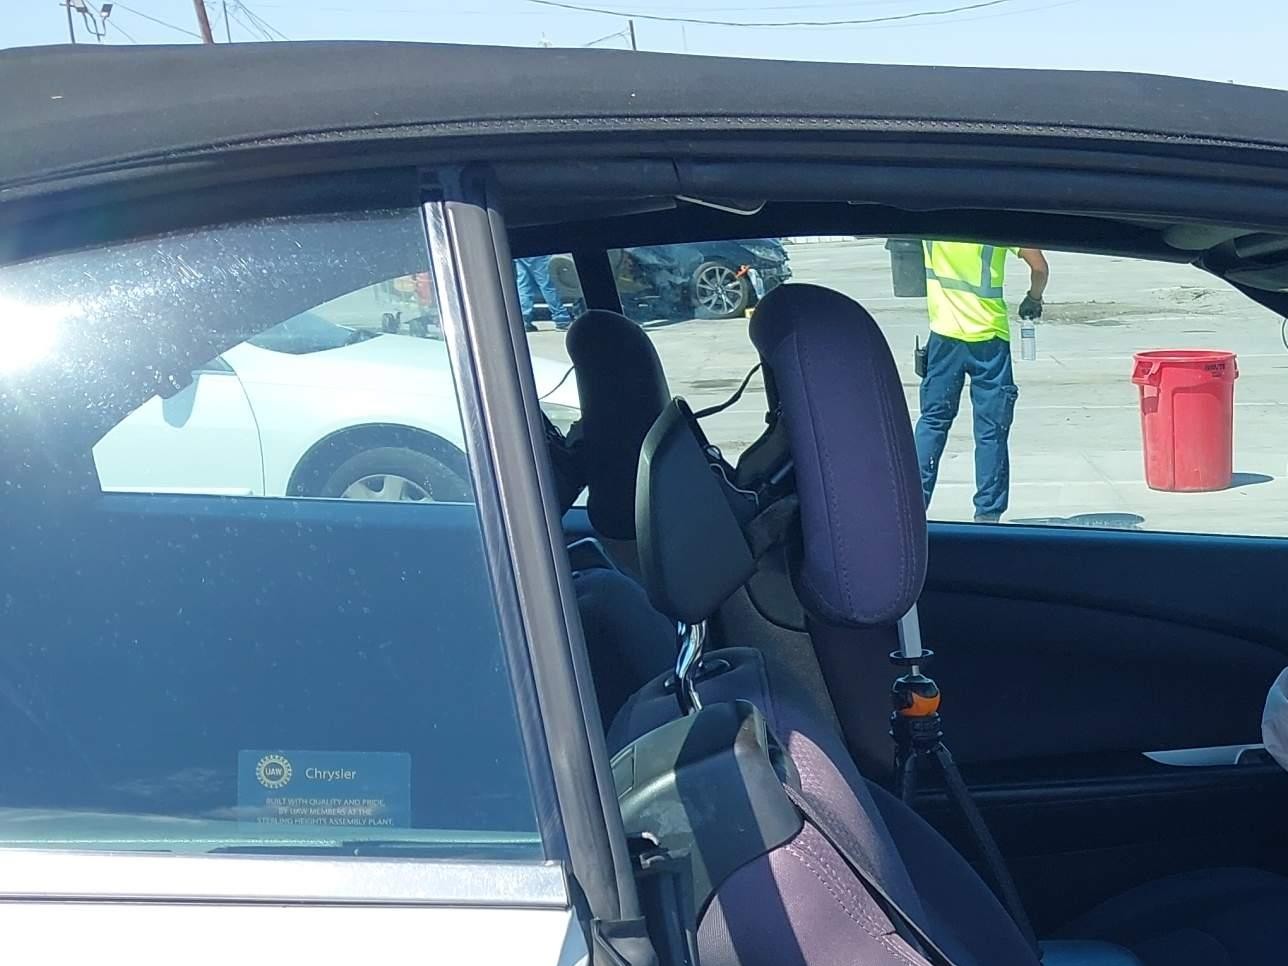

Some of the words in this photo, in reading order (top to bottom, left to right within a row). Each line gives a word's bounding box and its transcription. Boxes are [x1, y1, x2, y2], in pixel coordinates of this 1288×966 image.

[265, 767, 283, 776] UAW
[305, 767, 357, 782] Chrysler
[287, 798, 307, 806] WITH
